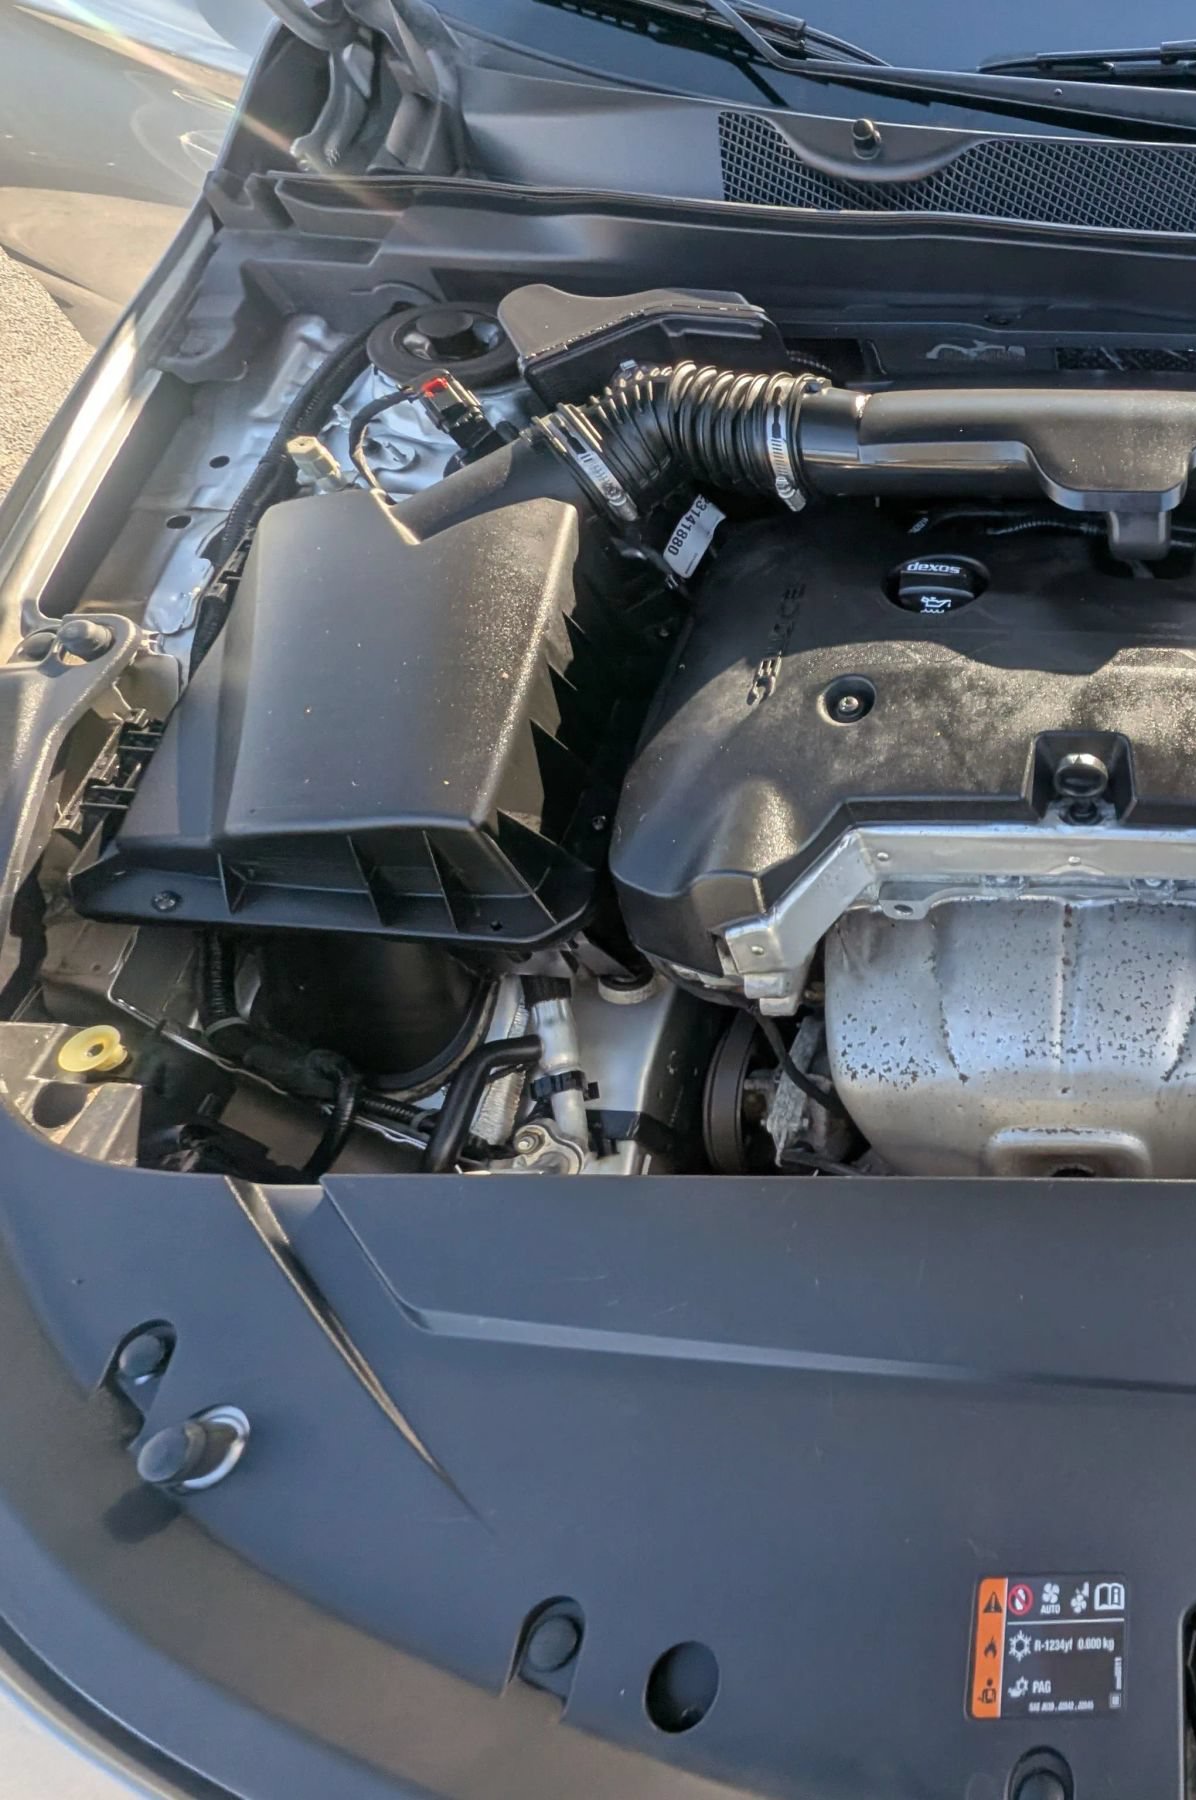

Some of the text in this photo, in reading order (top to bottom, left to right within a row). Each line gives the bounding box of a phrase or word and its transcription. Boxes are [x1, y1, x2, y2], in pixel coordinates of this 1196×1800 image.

[906, 561, 961, 574] dexos
[1040, 1603, 1061, 1615] AUTO
[1034, 1637, 1073, 1654] R-1234yf
[1102, 1636, 1115, 1652] kg
[1032, 1680, 1052, 1694] PAG
